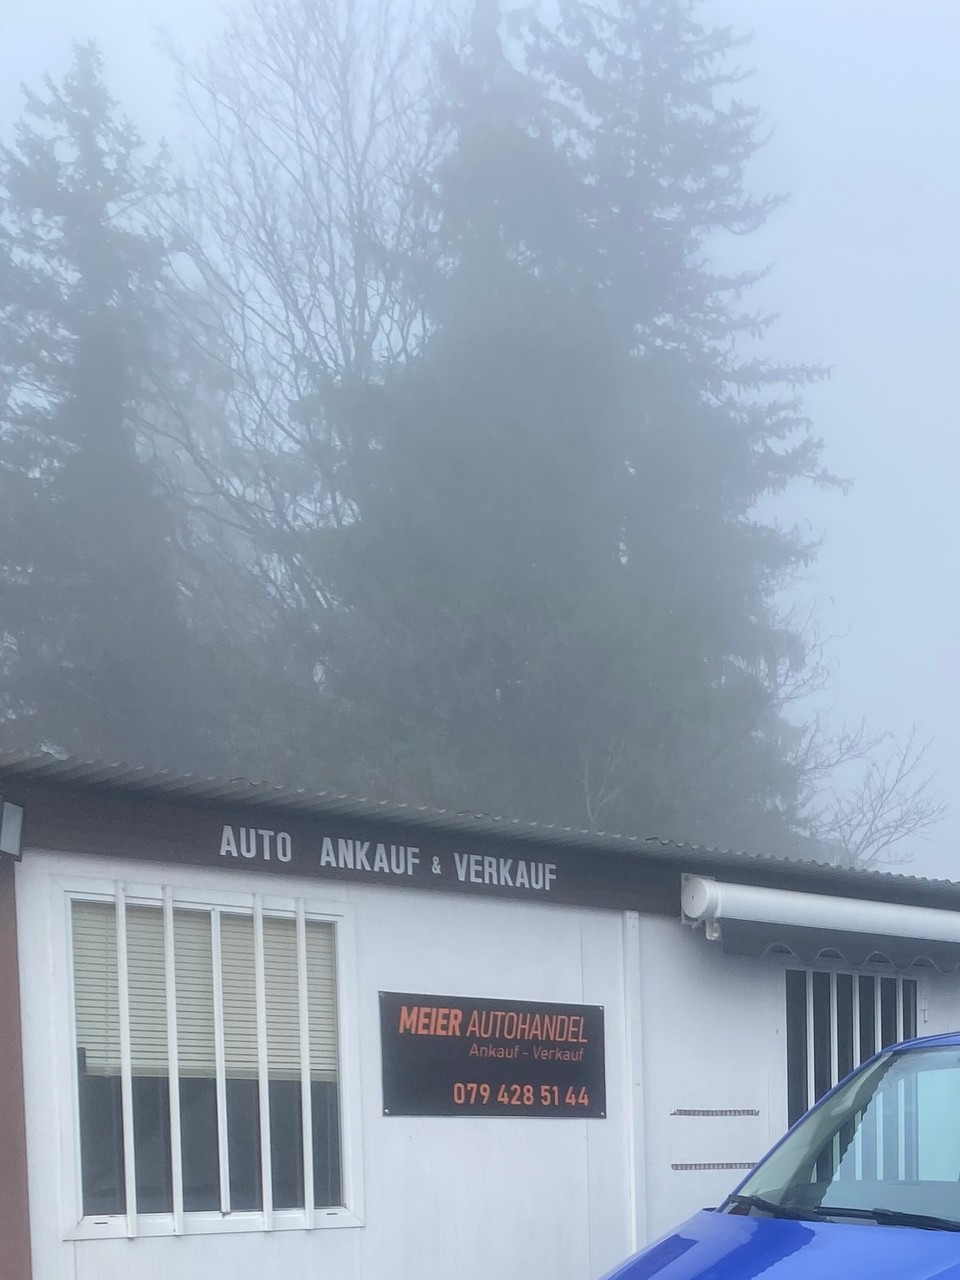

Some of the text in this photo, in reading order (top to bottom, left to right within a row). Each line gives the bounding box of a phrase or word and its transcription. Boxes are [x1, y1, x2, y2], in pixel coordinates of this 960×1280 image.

[220, 825, 557, 891] AUTO ANKAUF & VERKAUF
[399, 1005, 588, 1043] MEIER AUTOHANDEL
[469, 1043, 520, 1059] Ankauf
[533, 1046, 585, 1061] Verkauf
[453, 1083, 589, 1106] 079 428 51 44
